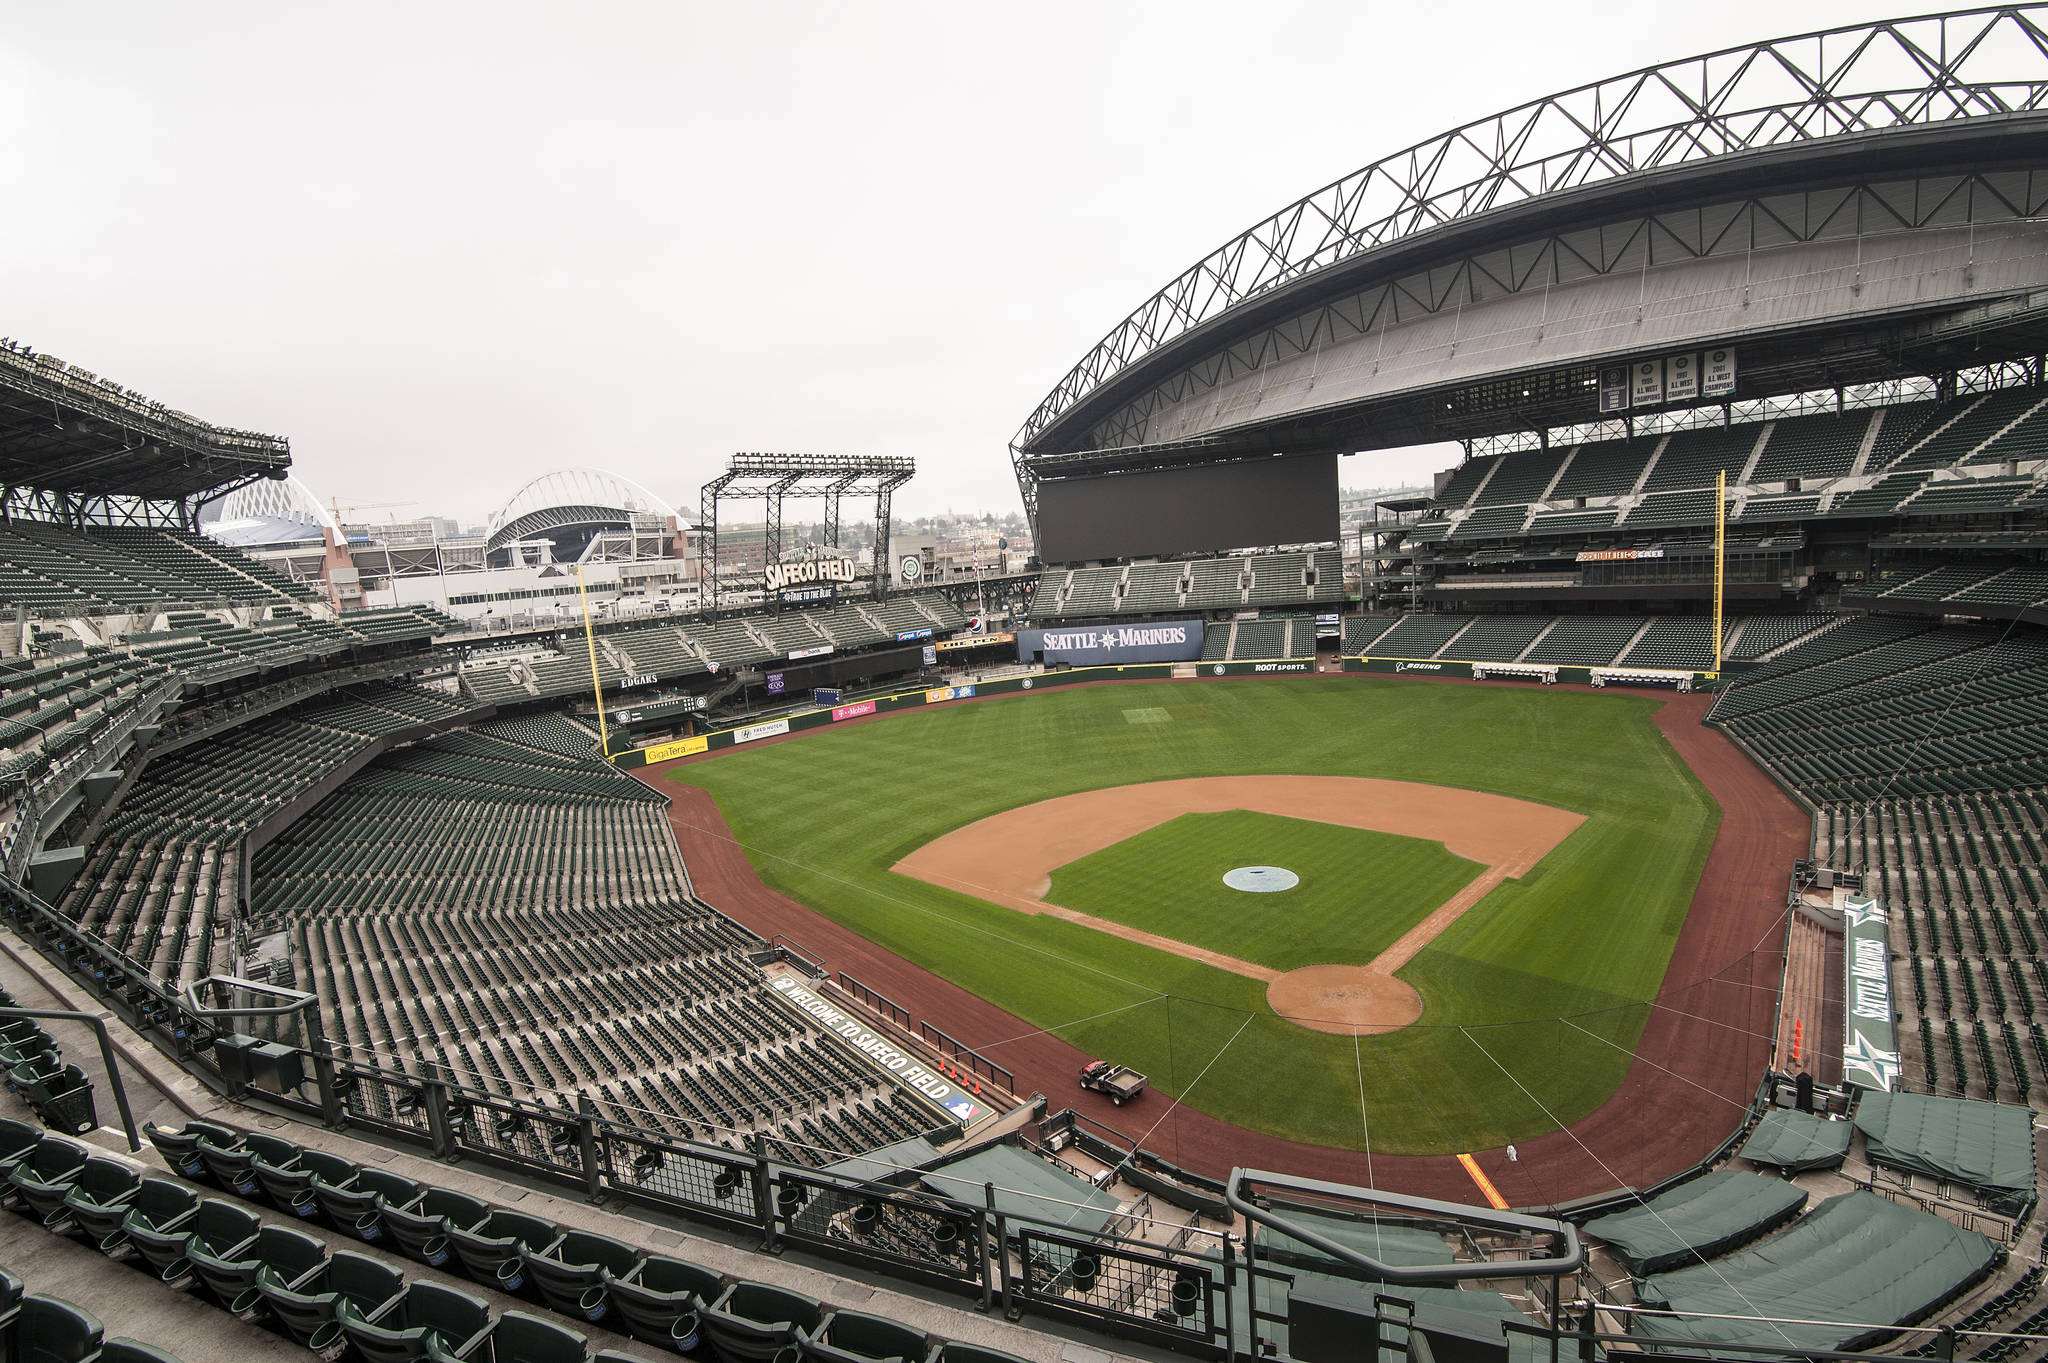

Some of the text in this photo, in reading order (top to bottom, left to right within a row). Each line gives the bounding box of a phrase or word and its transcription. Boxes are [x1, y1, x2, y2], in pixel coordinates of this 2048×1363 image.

[1717, 372, 1731, 380] WEST
[1680, 379, 1692, 387] WEST
[1705, 381, 1733, 392] CHAMPIONS
[1634, 393, 1660, 404] CHAMPIONS
[1668, 387, 1696, 398] CHAMPIONS
[765, 558, 856, 591] SAFECO FIELD
[790, 588, 832, 602] TRUE TO THE BLUE
[1043, 627, 1186, 650] SEATTLE MARINERS
[1255, 663, 1277, 672] ROOT
[648, 745, 686, 761] GigaTera
[1852, 937, 1889, 1023] SEATTLE MARINERS
[786, 986, 951, 1100] WELCOME TO SAFECO FIELD
